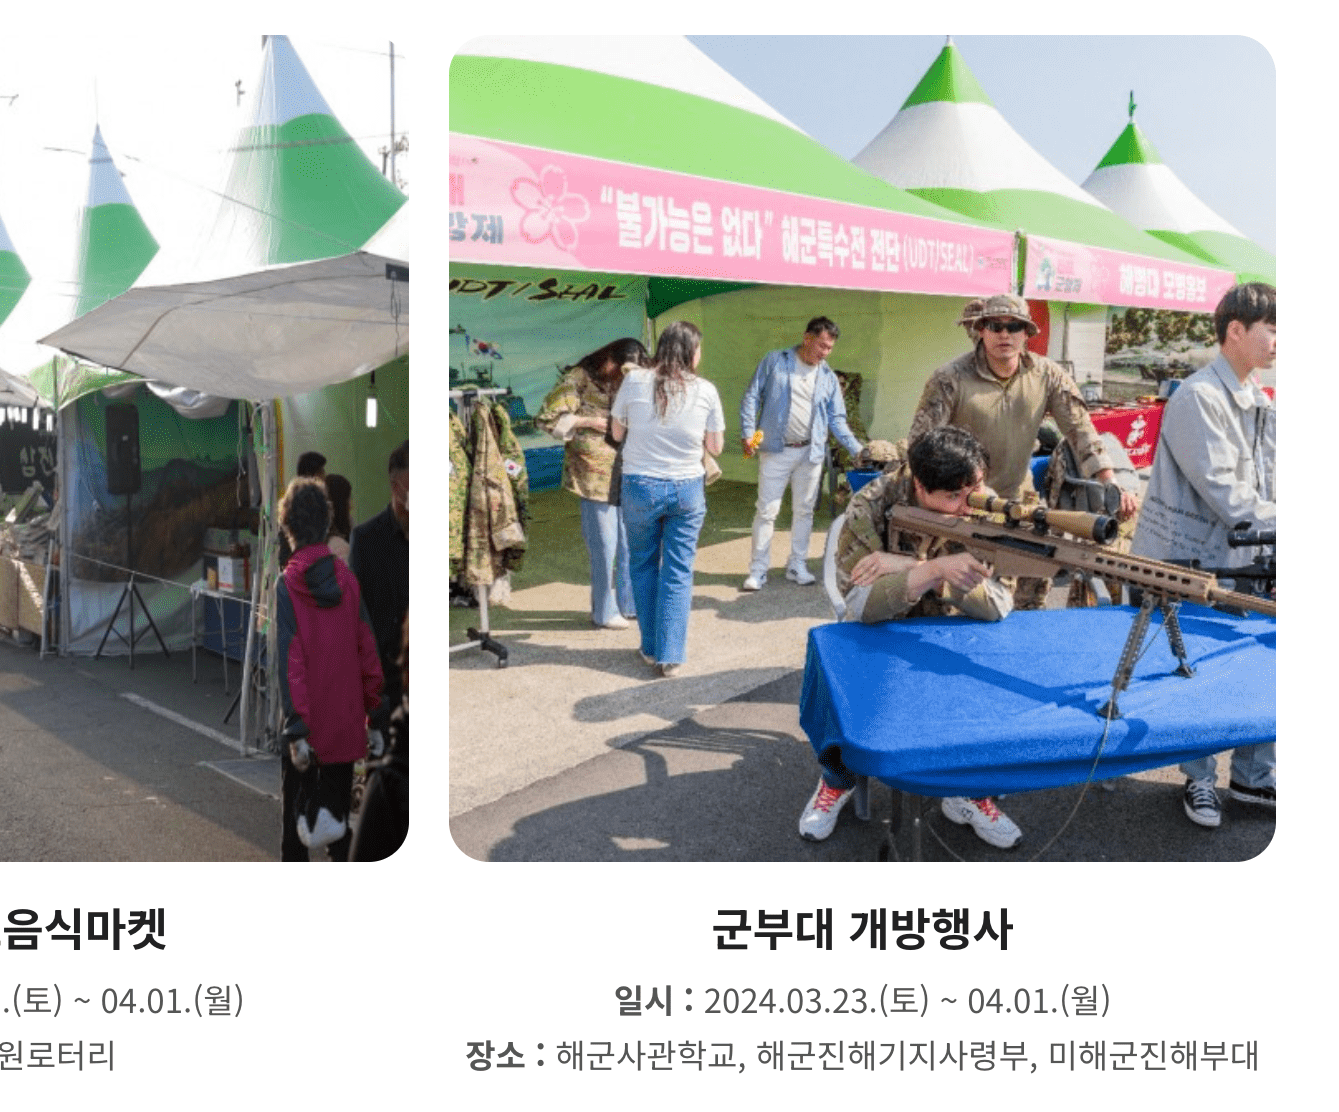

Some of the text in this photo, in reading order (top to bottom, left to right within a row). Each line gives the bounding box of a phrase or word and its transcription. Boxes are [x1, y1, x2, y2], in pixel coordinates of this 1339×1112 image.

[601, 185, 713, 255] “불가능은
[722, 206, 773, 261] 없다”
[780, 214, 866, 271] 해군특수전
